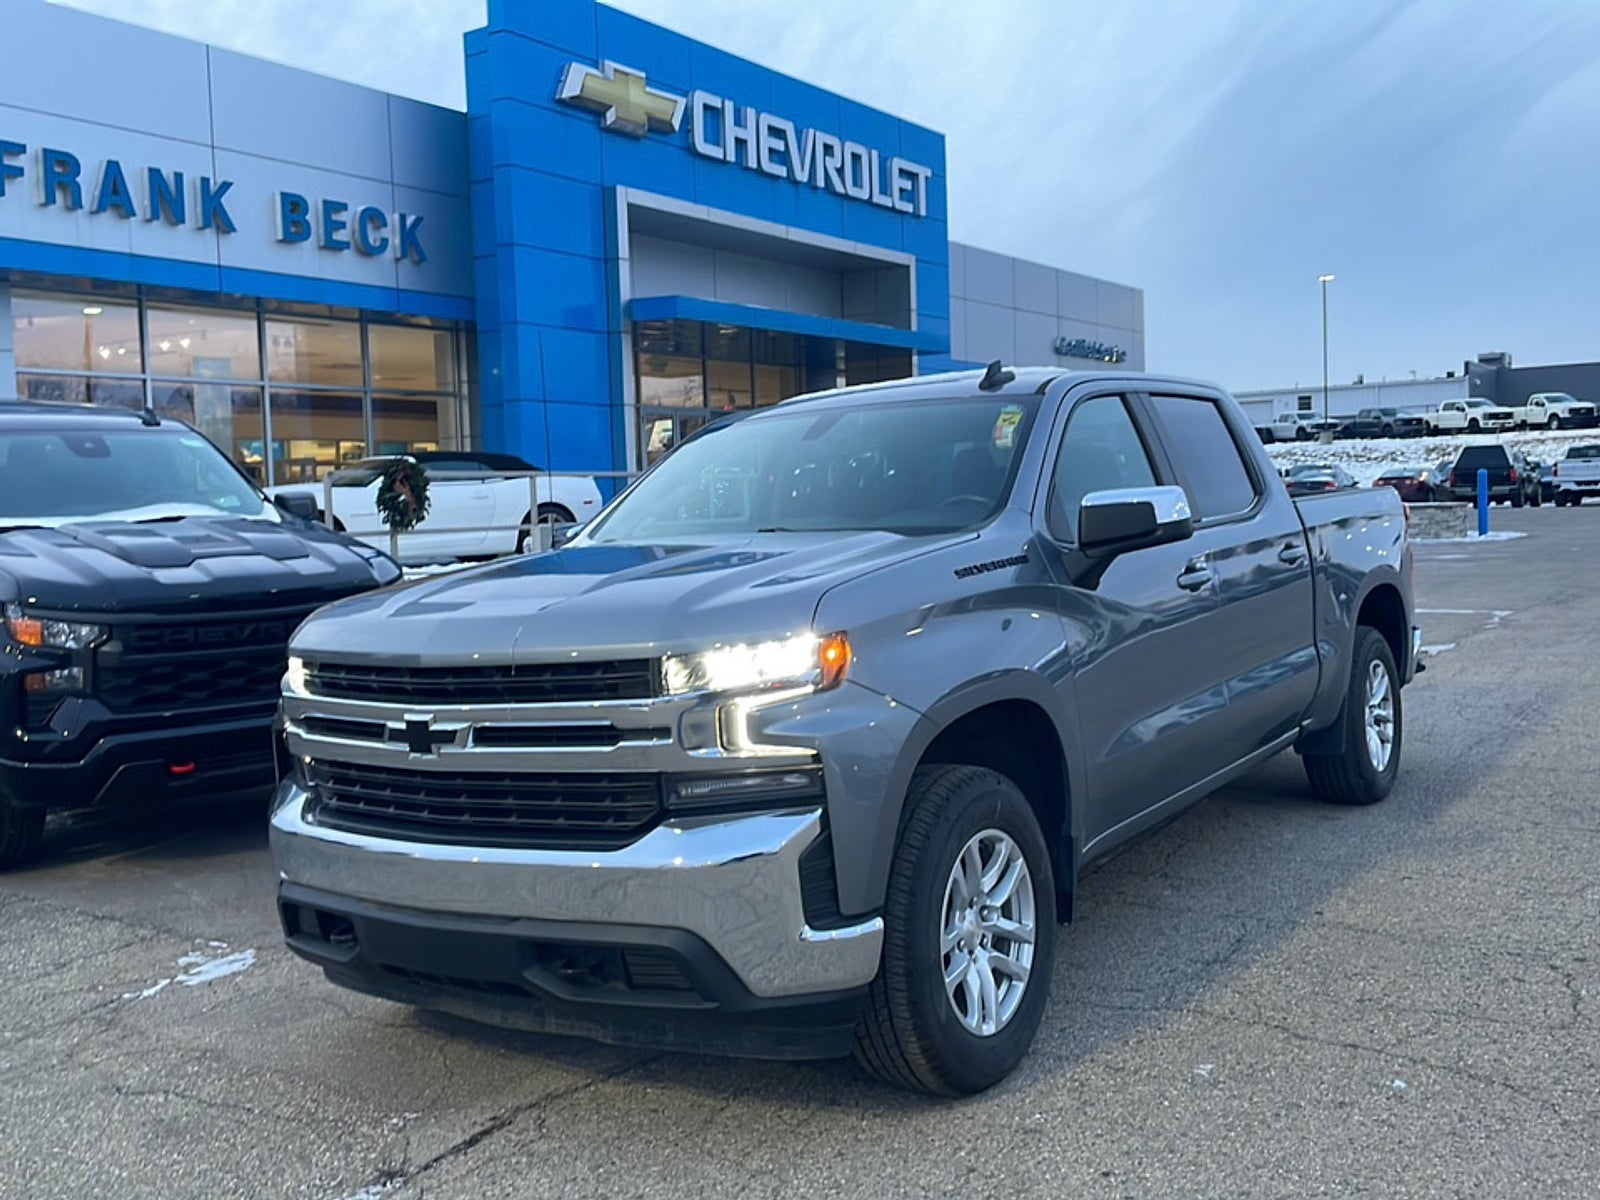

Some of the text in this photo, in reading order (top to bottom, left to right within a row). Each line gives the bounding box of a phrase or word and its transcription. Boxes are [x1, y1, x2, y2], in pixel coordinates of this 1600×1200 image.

[0, 139, 427, 264] FRANK BECK
[687, 90, 932, 217] CHEVROLET
